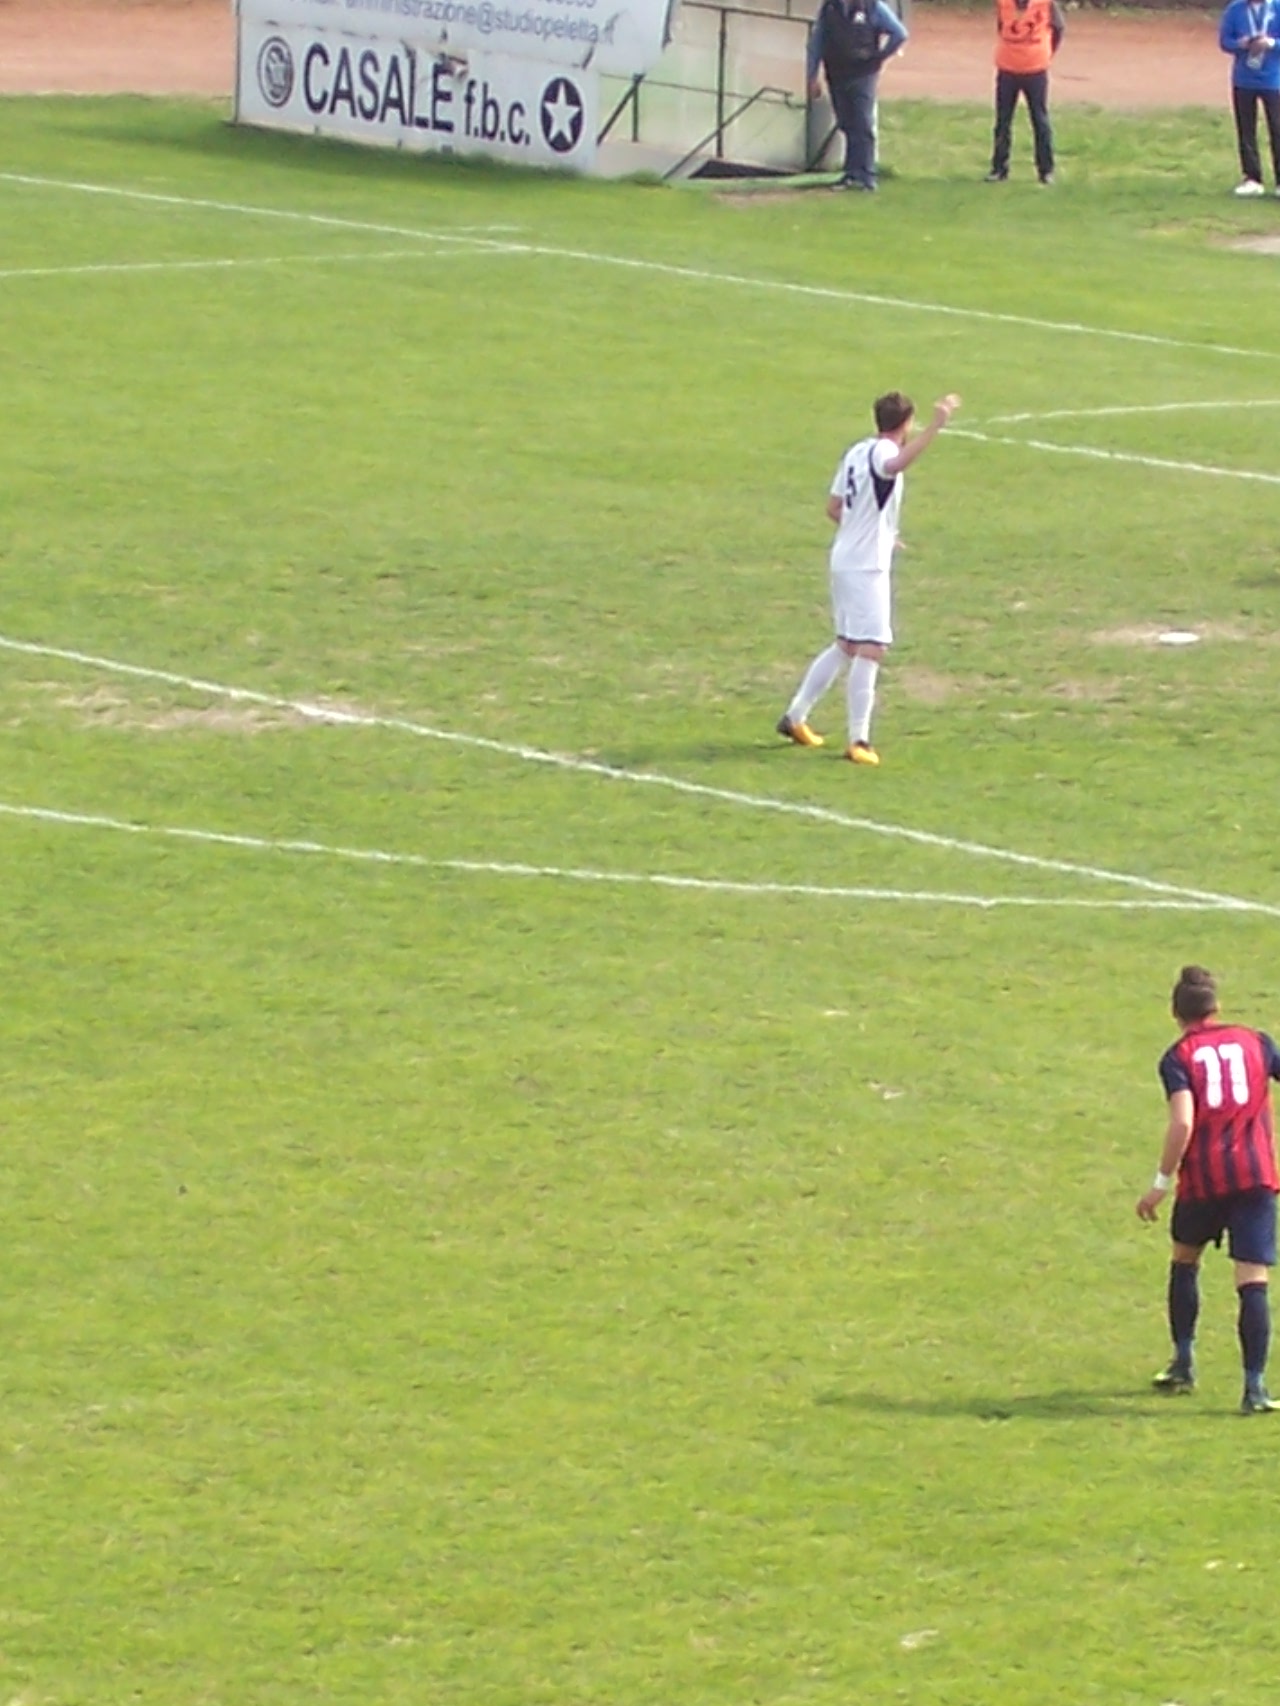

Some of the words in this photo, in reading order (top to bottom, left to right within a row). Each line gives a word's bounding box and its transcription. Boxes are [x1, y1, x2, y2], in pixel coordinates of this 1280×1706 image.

[303, 42, 455, 133] CASALE
[464, 79, 532, 146] f.b.c.
[845, 465, 857, 509] 5
[1192, 1042, 1250, 1109] 11
